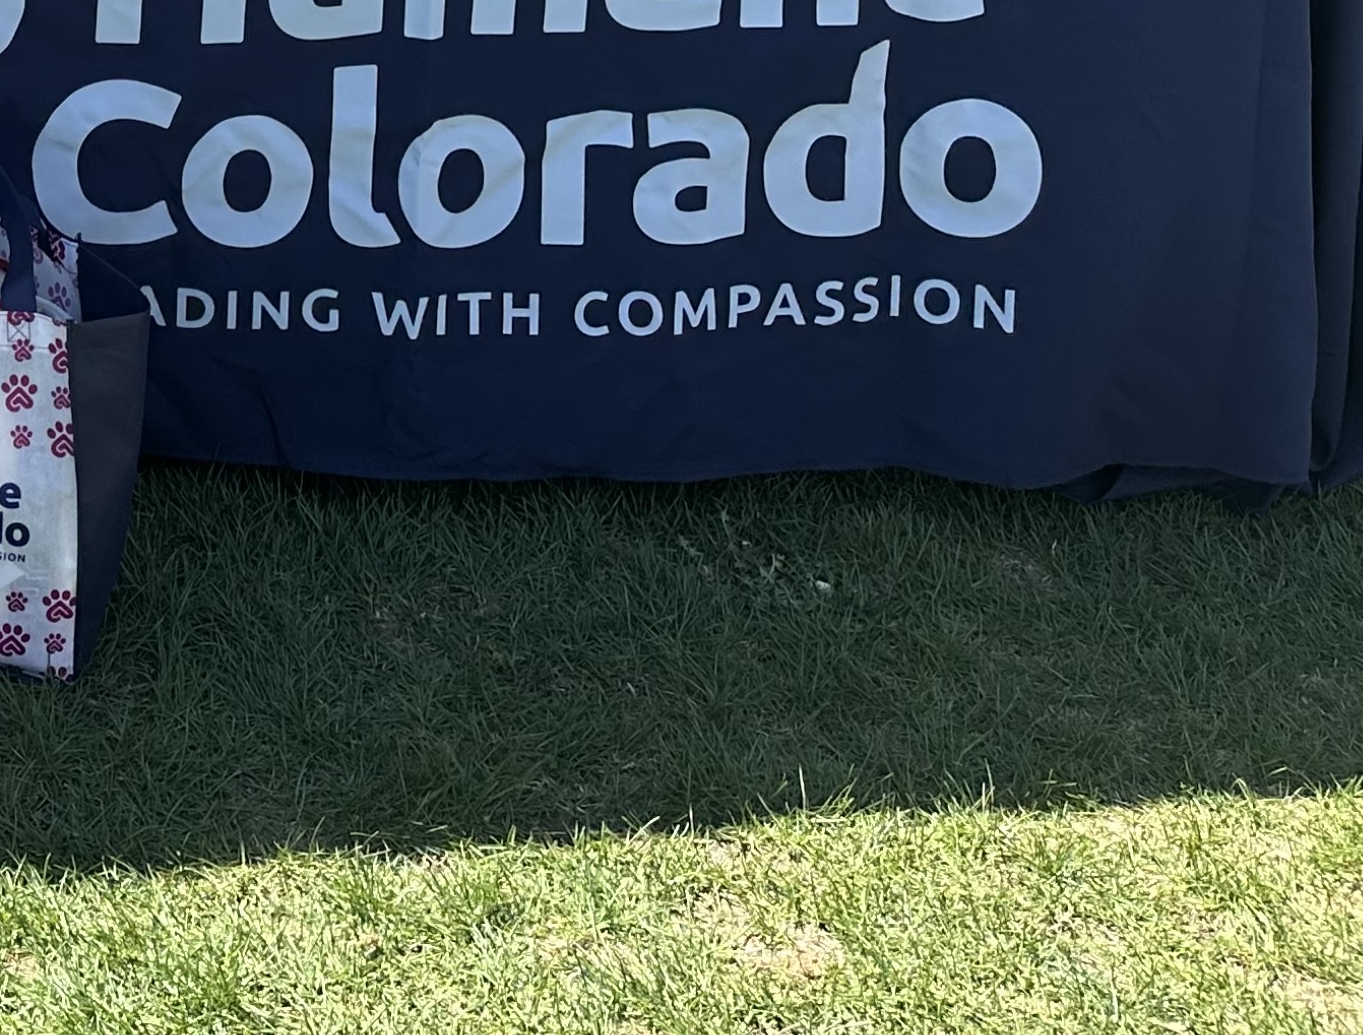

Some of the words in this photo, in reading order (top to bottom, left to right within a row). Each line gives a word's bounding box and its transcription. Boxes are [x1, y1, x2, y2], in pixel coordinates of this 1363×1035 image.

[31, 39, 1043, 249] Colorado
[371, 291, 540, 341] WITH
[573, 274, 1016, 337] COMPASSION
